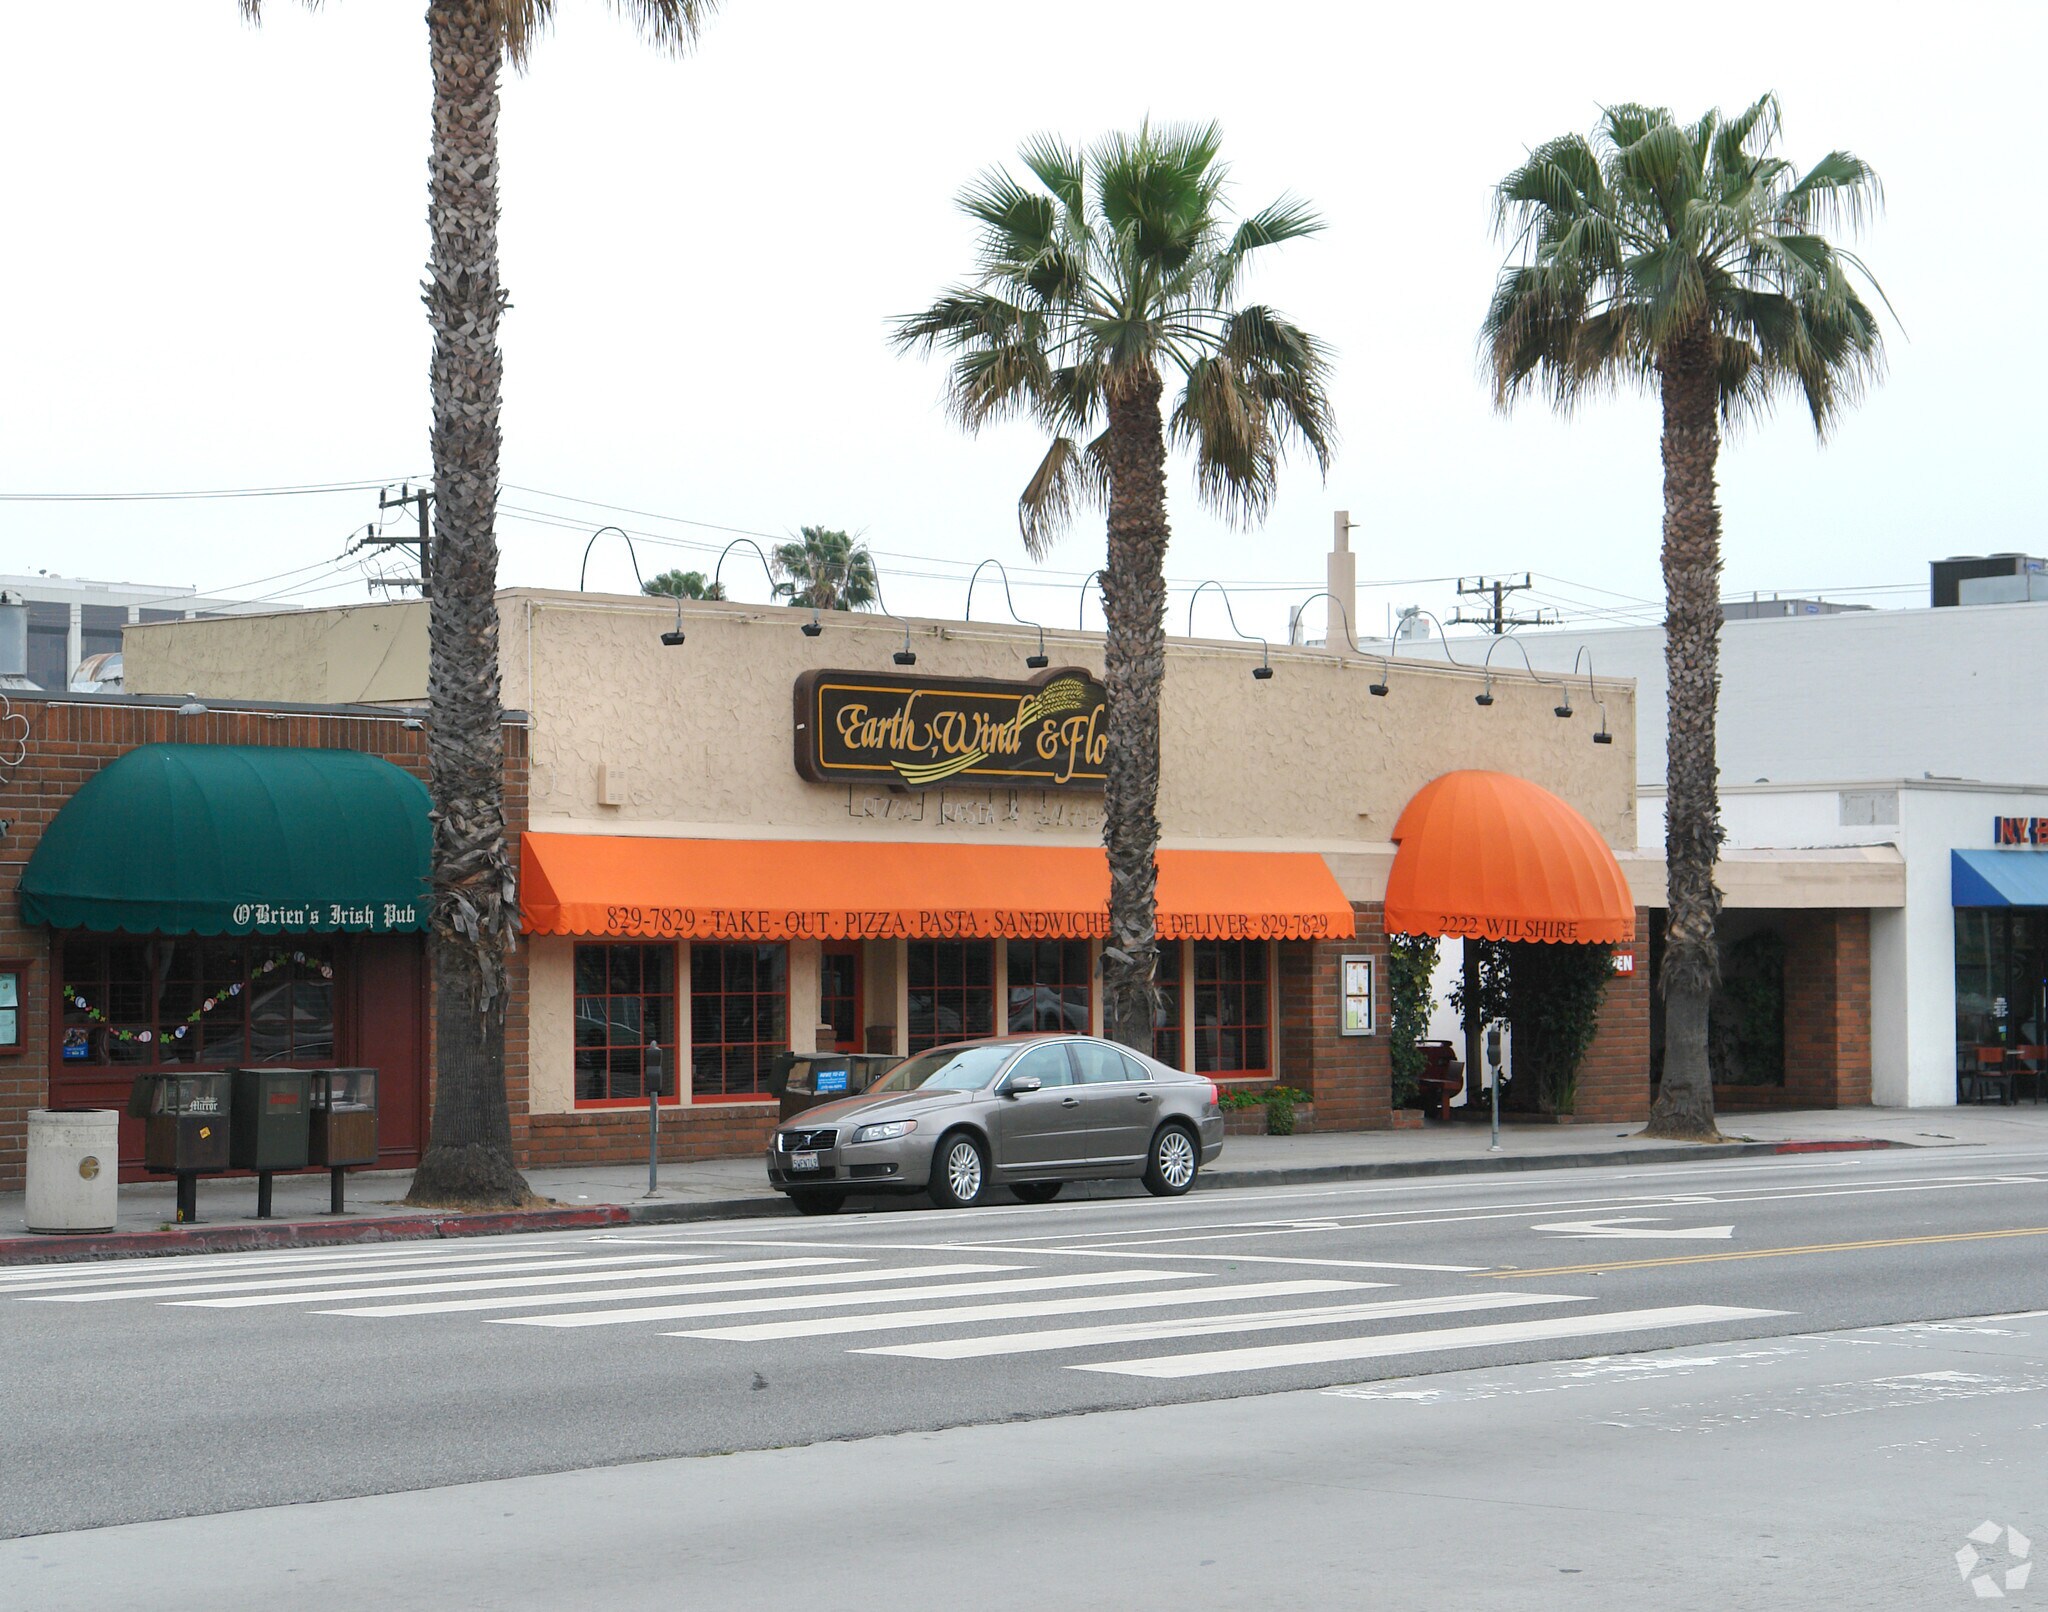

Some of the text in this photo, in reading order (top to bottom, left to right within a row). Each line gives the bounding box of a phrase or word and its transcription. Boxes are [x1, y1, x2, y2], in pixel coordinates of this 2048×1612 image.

[836, 690, 939, 758] Earth,
[934, 694, 1035, 755] Wind
[1054, 703, 1108, 784] Flo
[232, 903, 416, 929] O'Brien's Irish Pub
[607, 906, 696, 932] 829-7829
[844, 911, 907, 934] PIZZA
[919, 910, 978, 933] PASTA
[993, 910, 1112, 934] SANDWICHE
[1171, 913, 1250, 935] DELIVER
[1261, 912, 1329, 935] 829-7829
[1438, 915, 1579, 939] 2222 WILSHIRE
[189, 1099, 219, 1112] Mirror
